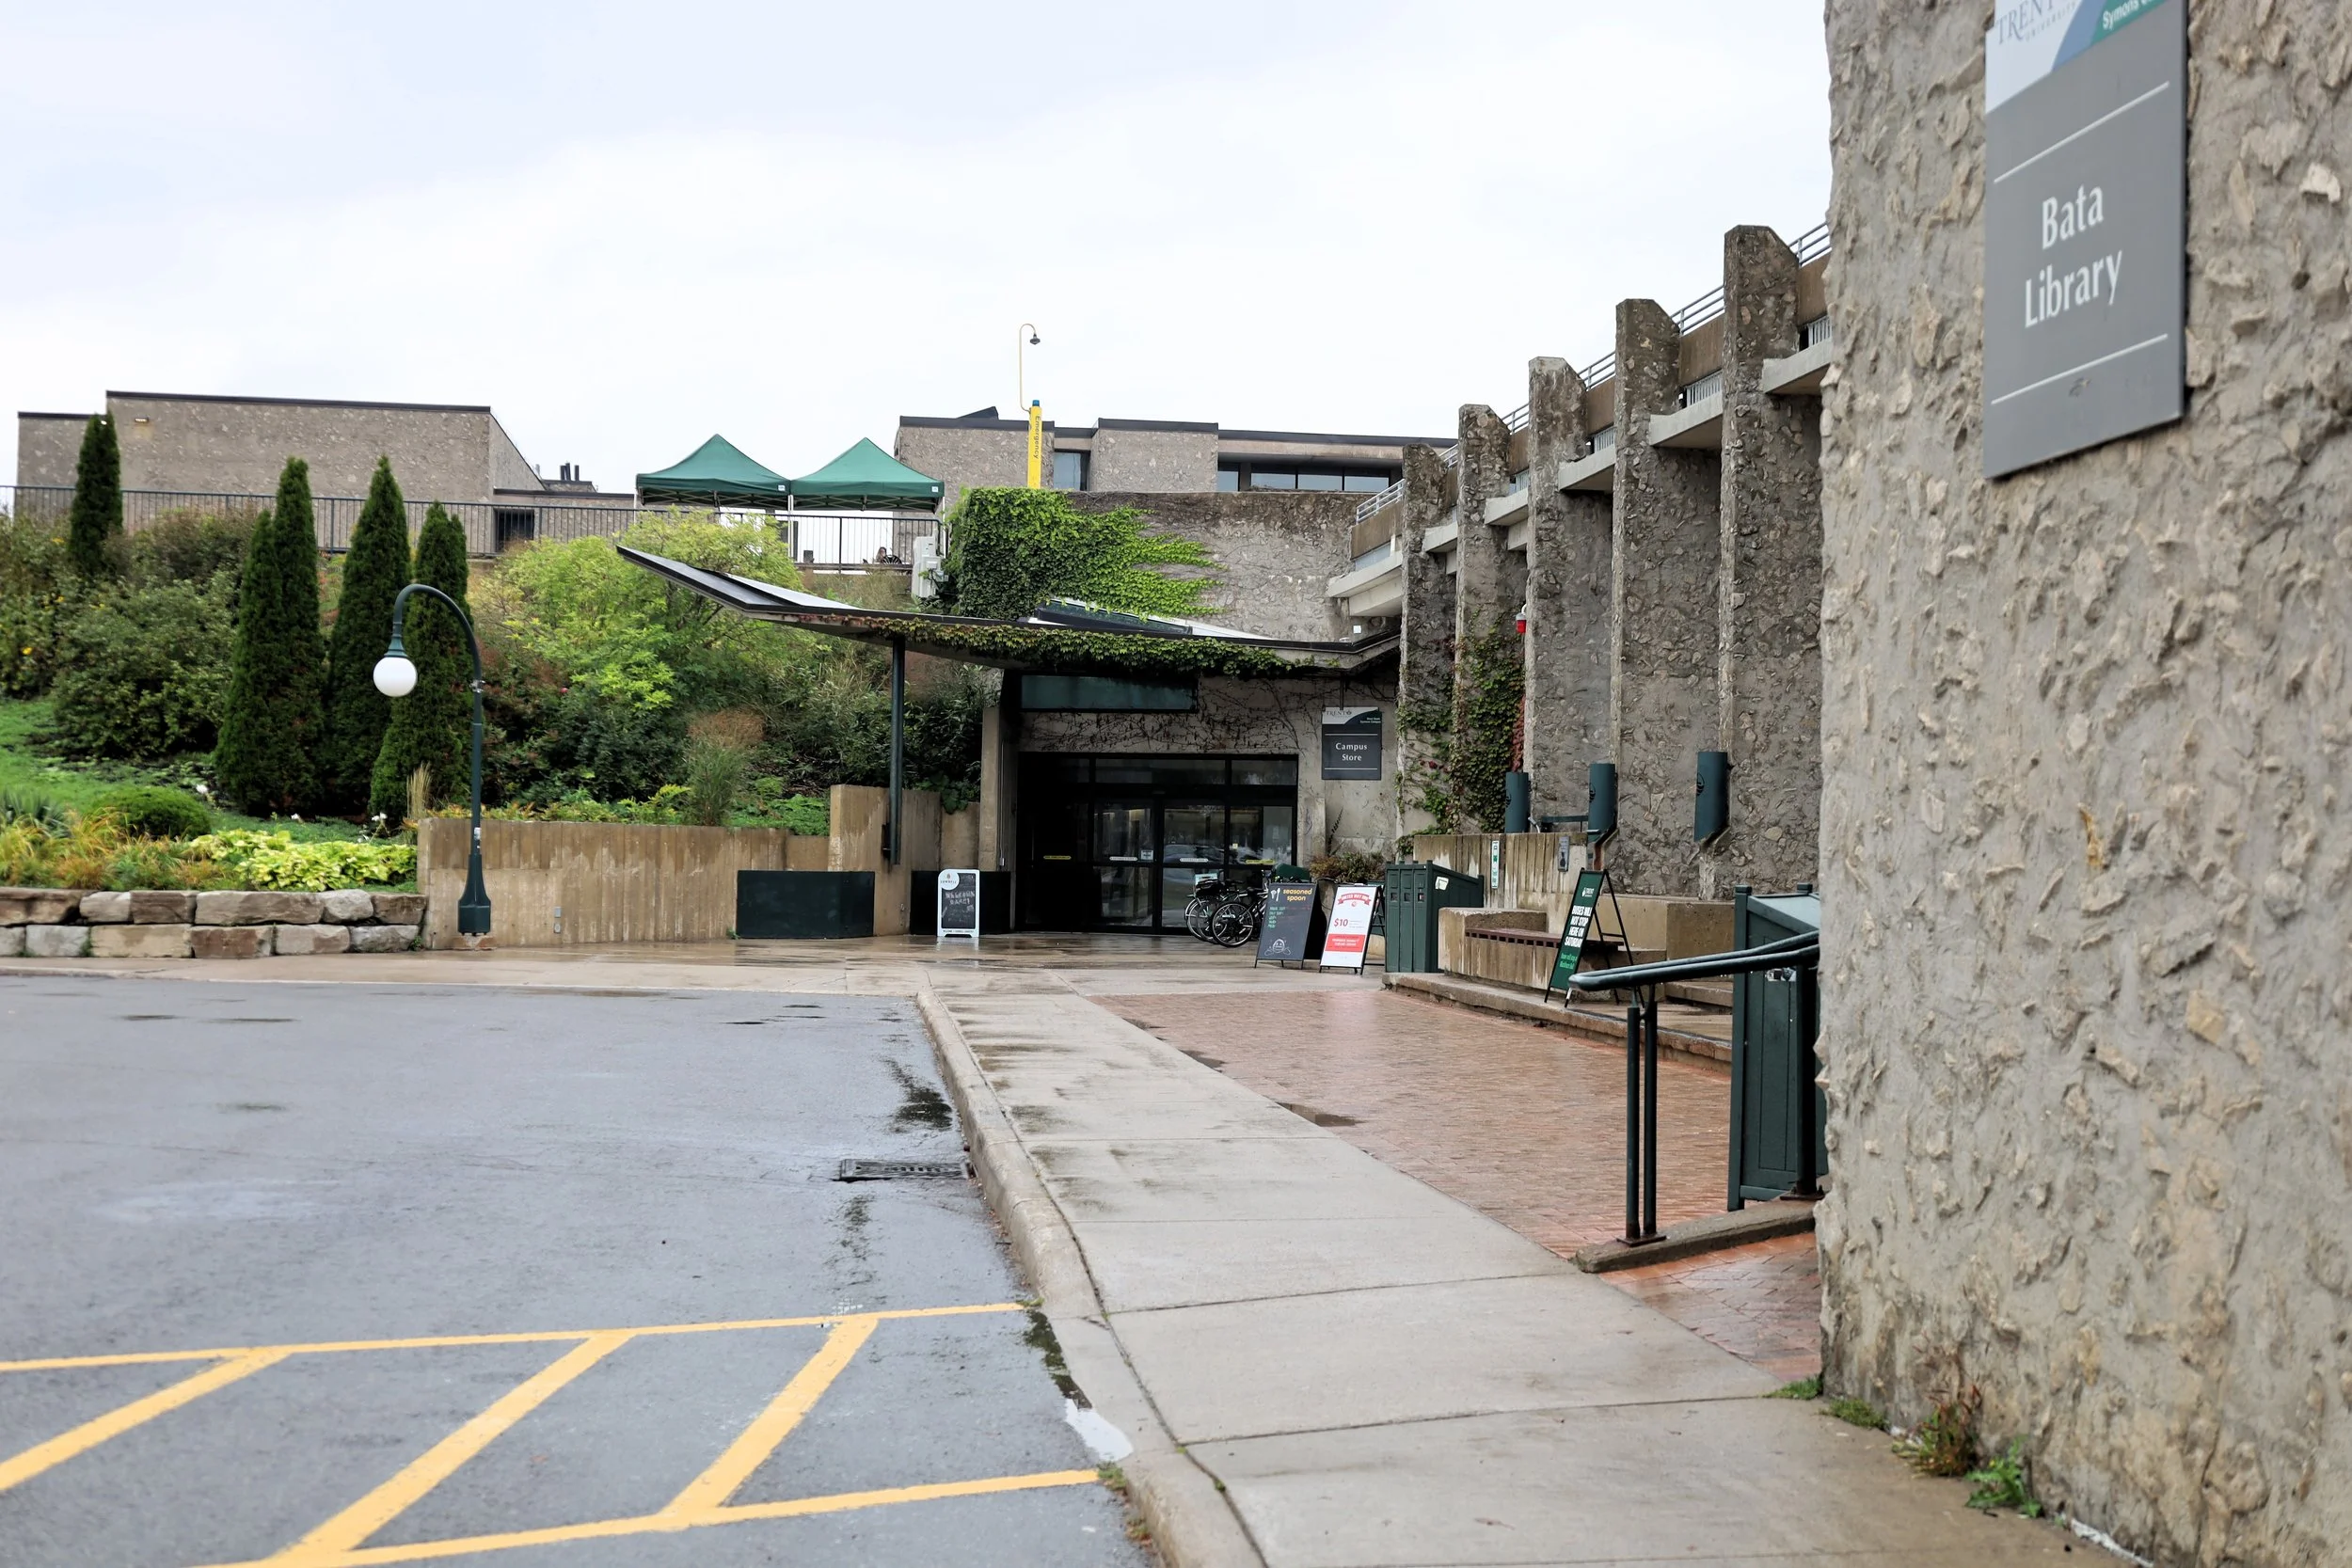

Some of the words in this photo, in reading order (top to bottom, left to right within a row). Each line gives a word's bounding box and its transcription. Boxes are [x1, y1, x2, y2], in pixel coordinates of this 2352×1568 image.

[2103, 0, 2138, 31] Symons
[2042, 185, 2104, 249] Bata
[2025, 250, 2122, 328] Library
[1335, 742, 1367, 751] Campus
[1572, 905, 1584, 915] BUSES
[1333, 918, 1348, 927] $10
[1570, 916, 1580, 926] NOT
[1579, 916, 1589, 927] STOP
[1568, 926, 1579, 937] HERE
[1578, 927, 1585, 938] ON
